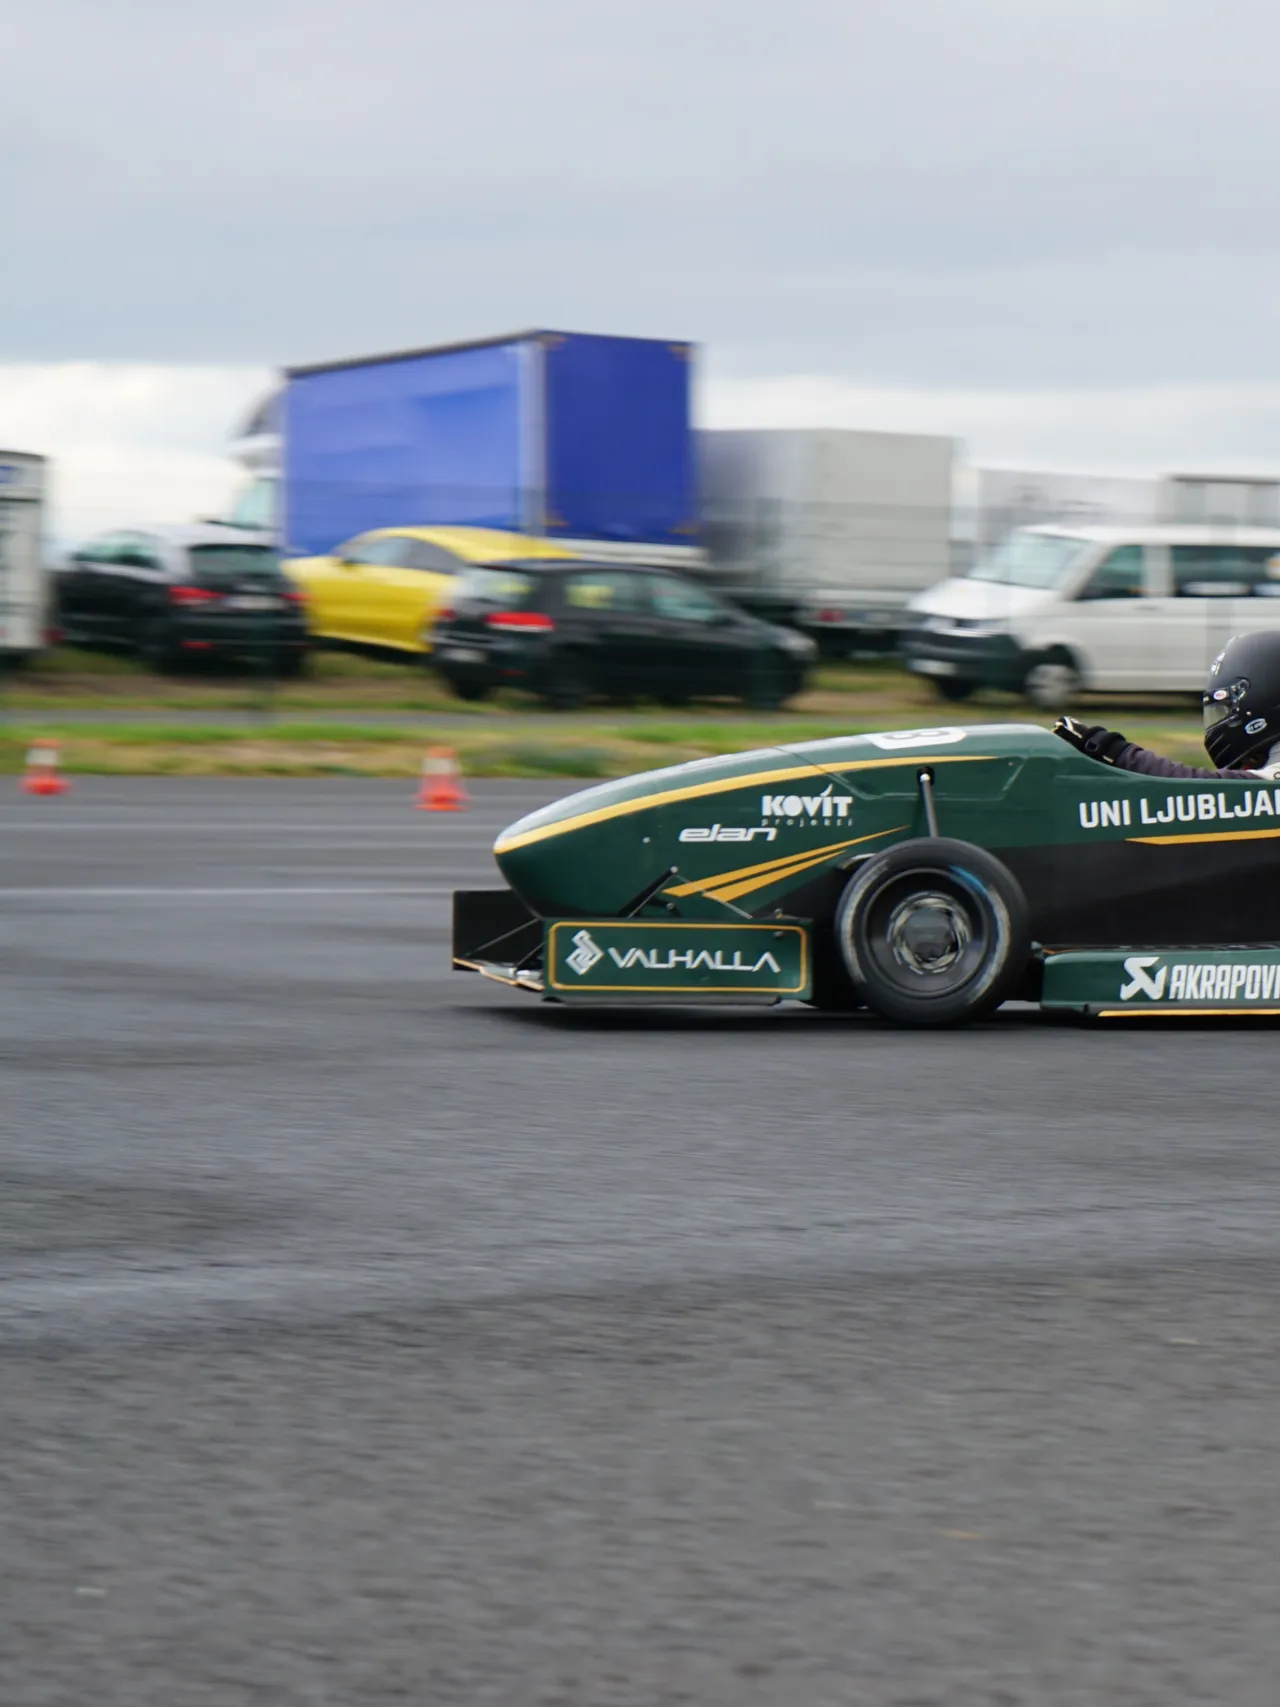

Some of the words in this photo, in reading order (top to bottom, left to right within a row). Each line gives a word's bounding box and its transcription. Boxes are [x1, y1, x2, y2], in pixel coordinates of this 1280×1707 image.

[1079, 799, 1131, 828] UNI
[678, 824, 777, 842] elan
[607, 947, 781, 973] VALHALLA
